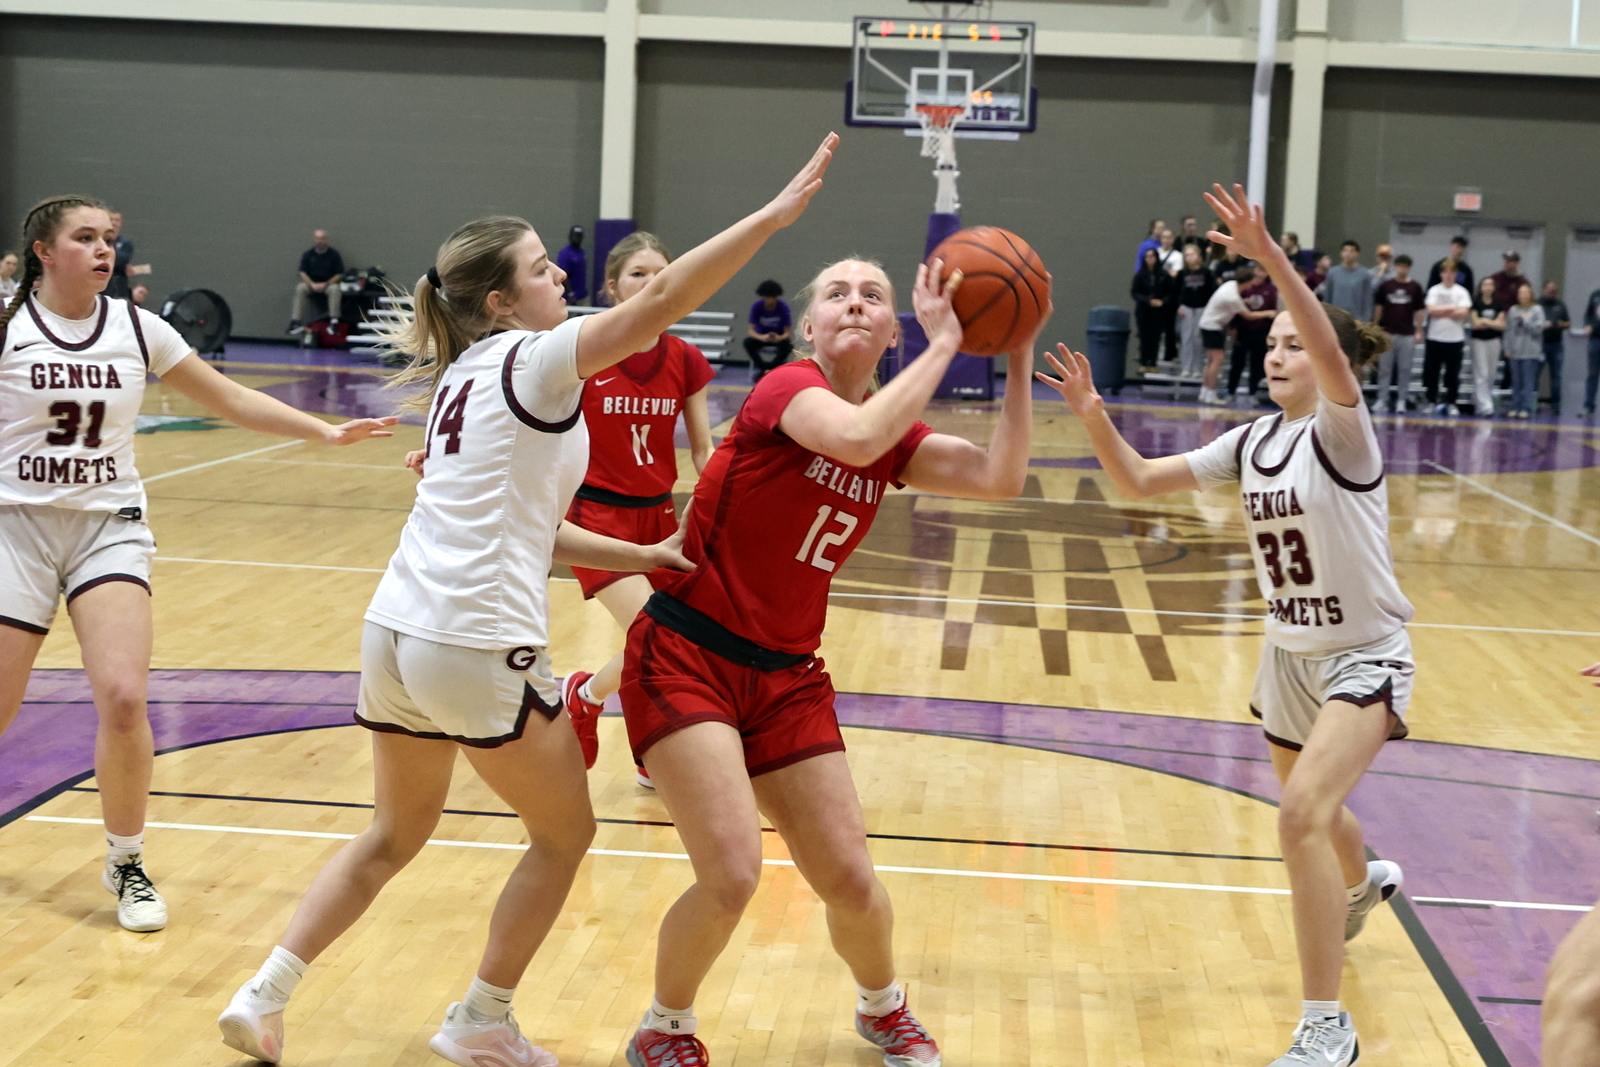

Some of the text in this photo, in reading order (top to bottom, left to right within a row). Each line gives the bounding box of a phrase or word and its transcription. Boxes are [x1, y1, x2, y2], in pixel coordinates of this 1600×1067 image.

[31, 363, 122, 389] GENOA
[46, 400, 106, 448] 31
[426, 378, 475, 458] 14
[603, 396, 677, 416] BELLEVUE
[631, 424, 654, 466] 11
[18, 455, 118, 484] COMETS
[795, 505, 858, 572] 12
[1256, 527, 1315, 588] 33
[506, 646, 536, 671] G
